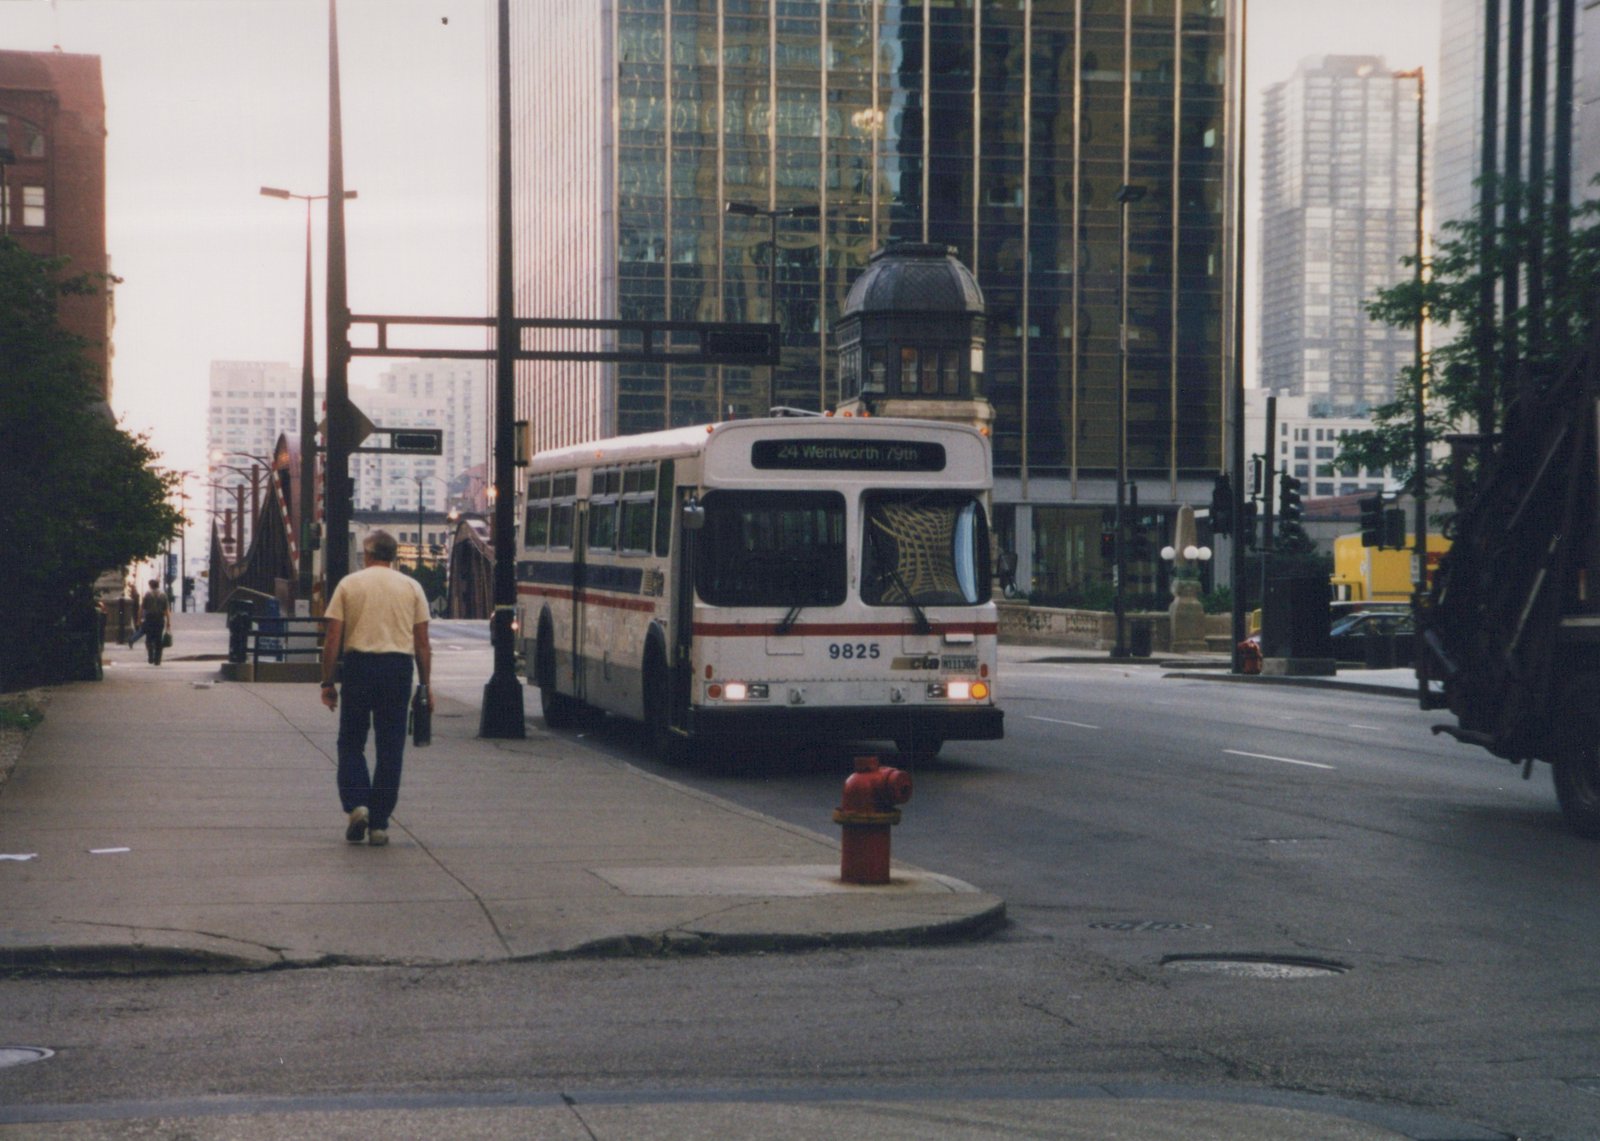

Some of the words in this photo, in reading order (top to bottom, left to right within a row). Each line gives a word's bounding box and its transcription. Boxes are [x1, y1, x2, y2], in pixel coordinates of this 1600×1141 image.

[778, 445, 799, 459] 24
[802, 445, 880, 460] Wentworth
[886, 447, 919, 461] 79th
[829, 643, 881, 660] 9825
